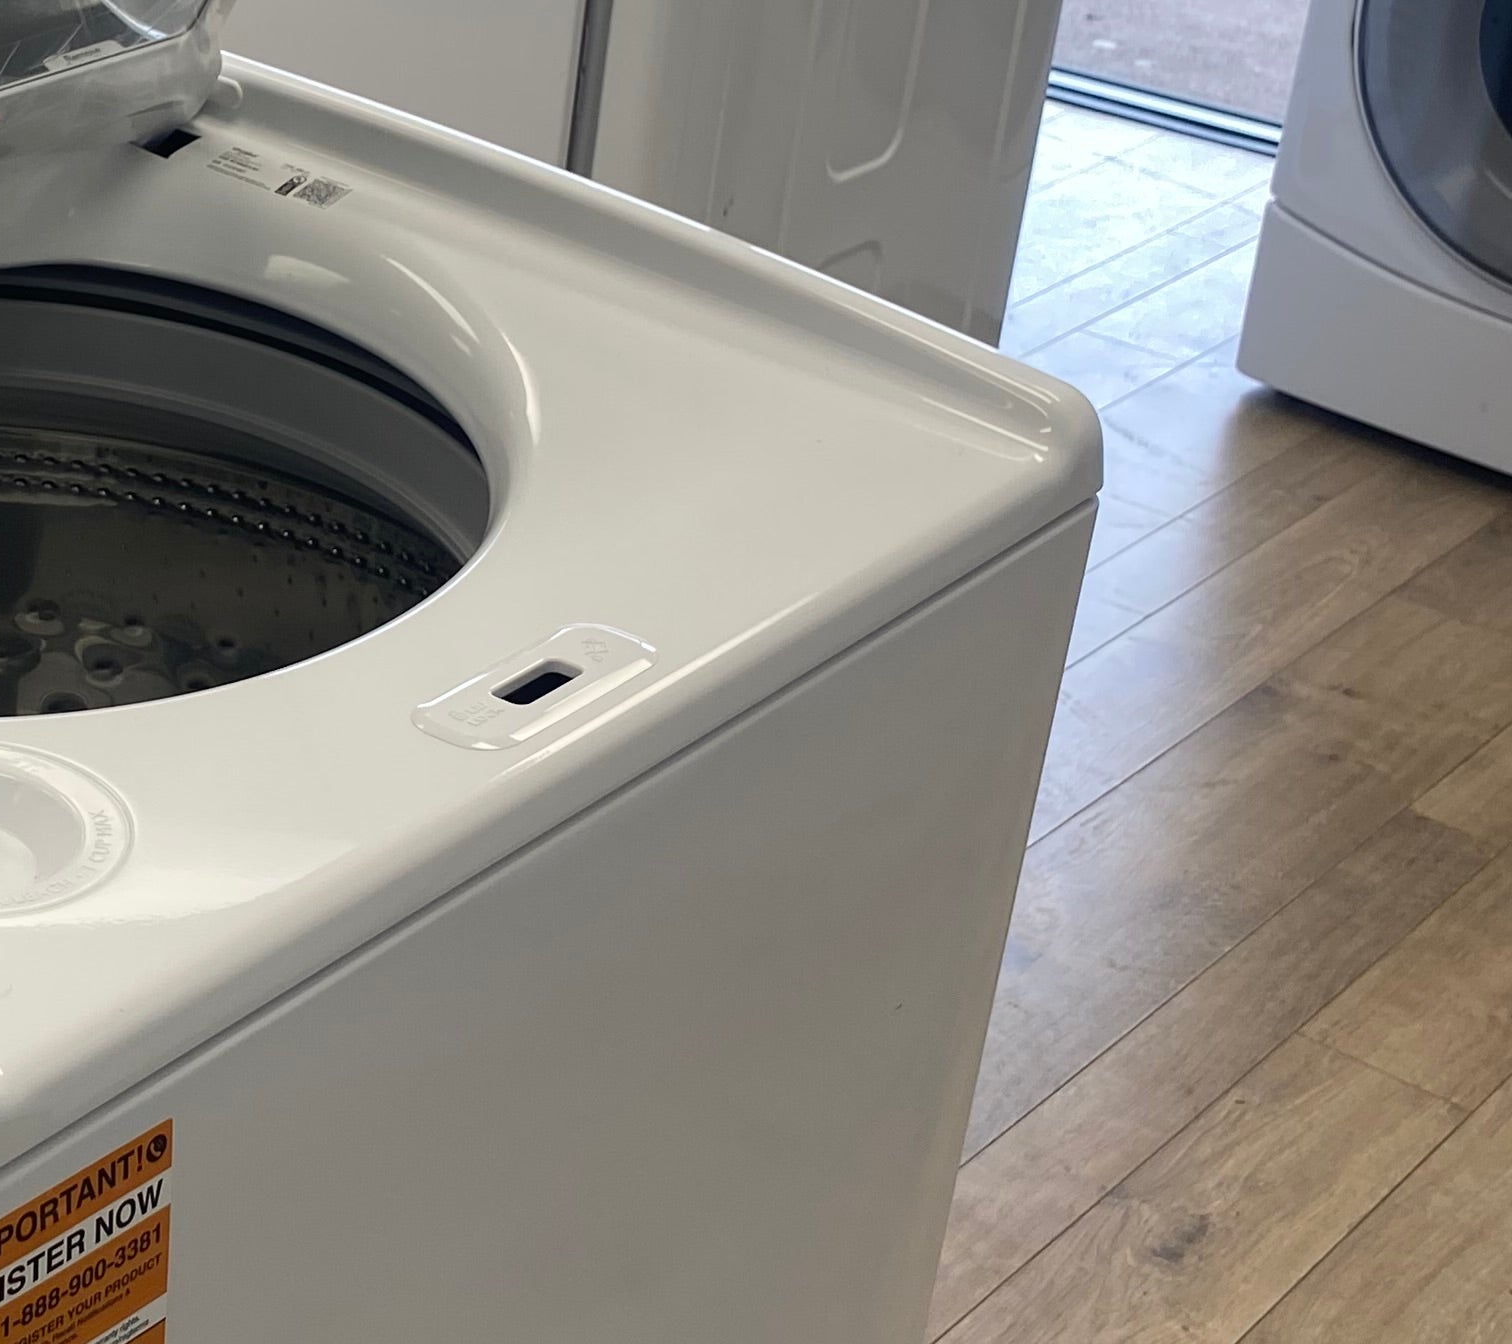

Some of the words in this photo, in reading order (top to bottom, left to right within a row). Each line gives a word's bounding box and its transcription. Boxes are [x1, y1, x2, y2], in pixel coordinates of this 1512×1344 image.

[94, 1178, 163, 1244] NOW
[1, 1222, 161, 1338] 1-888-900-3381
[67, 1290, 101, 1321] YOUR
[105, 1252, 162, 1296] PRODUCT
